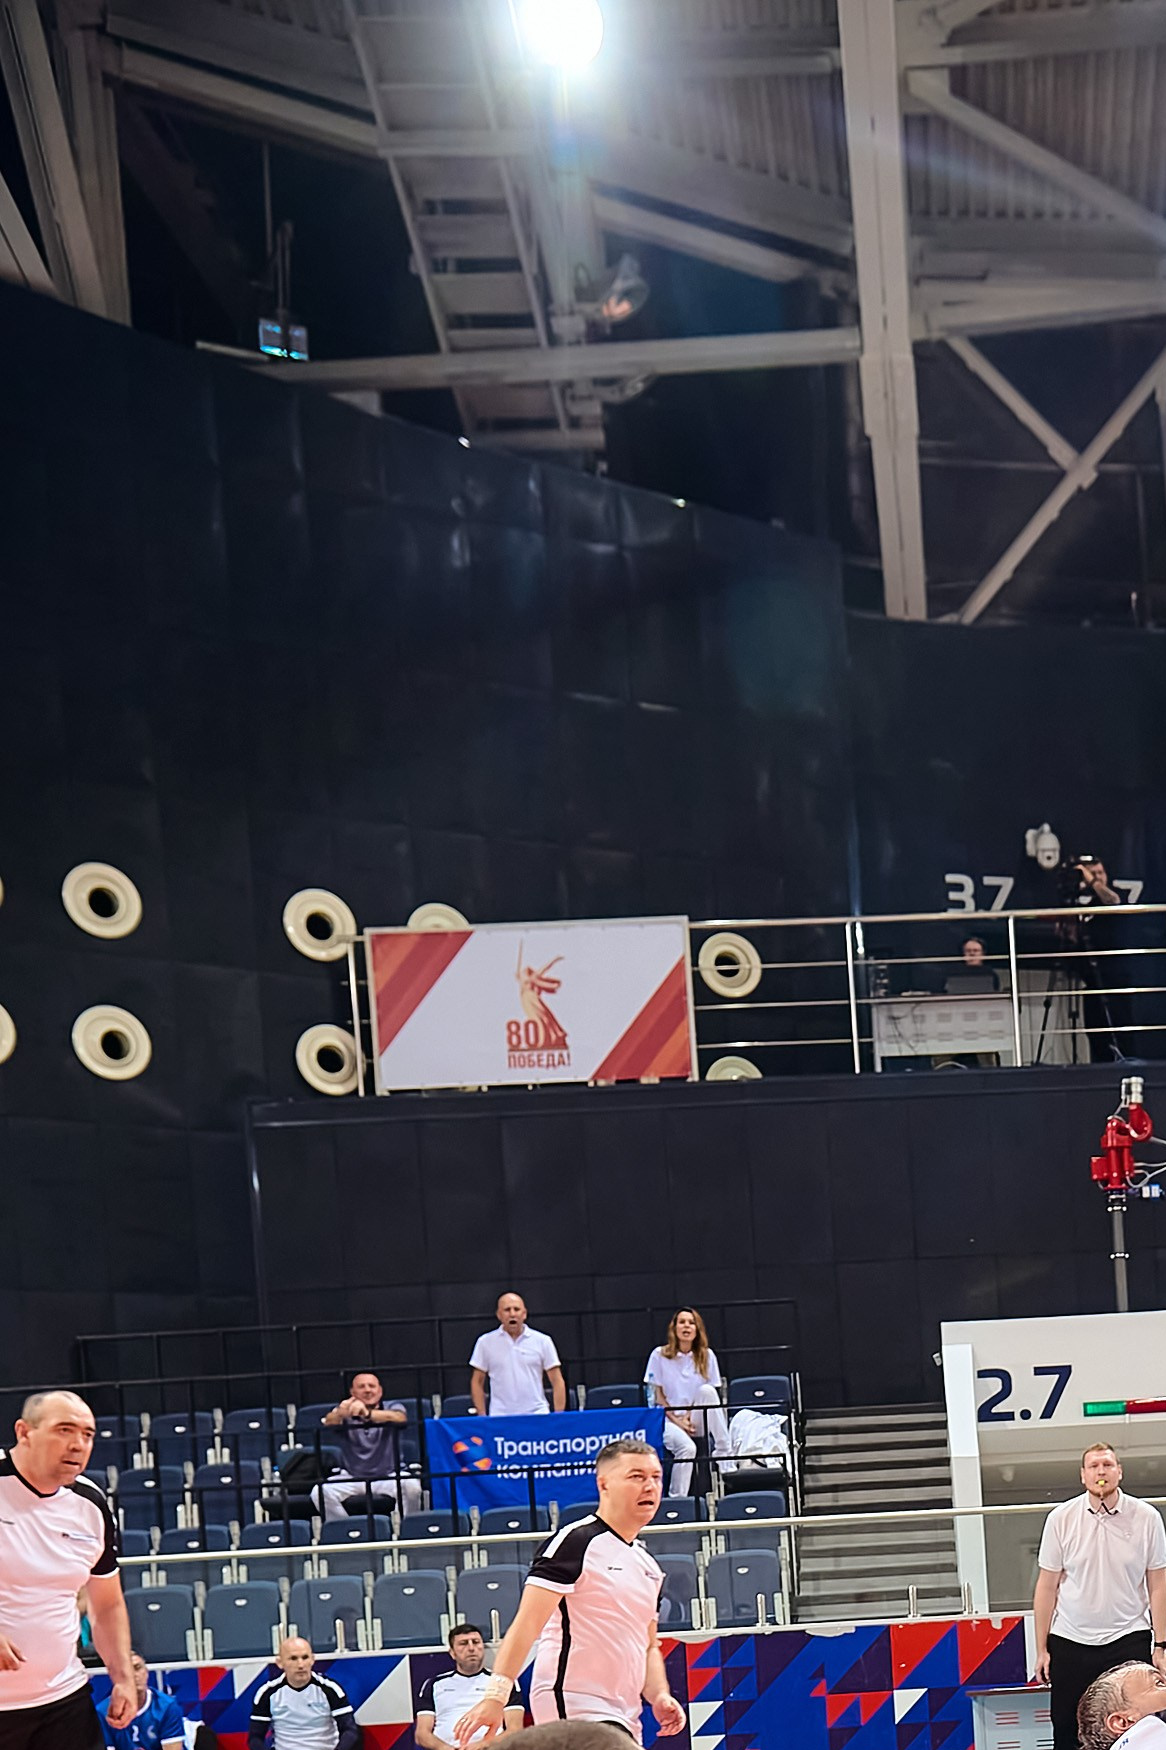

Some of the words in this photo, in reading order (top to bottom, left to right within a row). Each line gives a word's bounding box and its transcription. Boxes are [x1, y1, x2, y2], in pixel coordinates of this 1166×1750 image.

[506, 1019, 540, 1049] 80
[507, 1052, 571, 1069] ПОБЕДА!
[977, 1364, 1072, 1422] 2.7
[494, 1429, 646, 1458] Транспортная
[497, 1460, 597, 1479] компани
